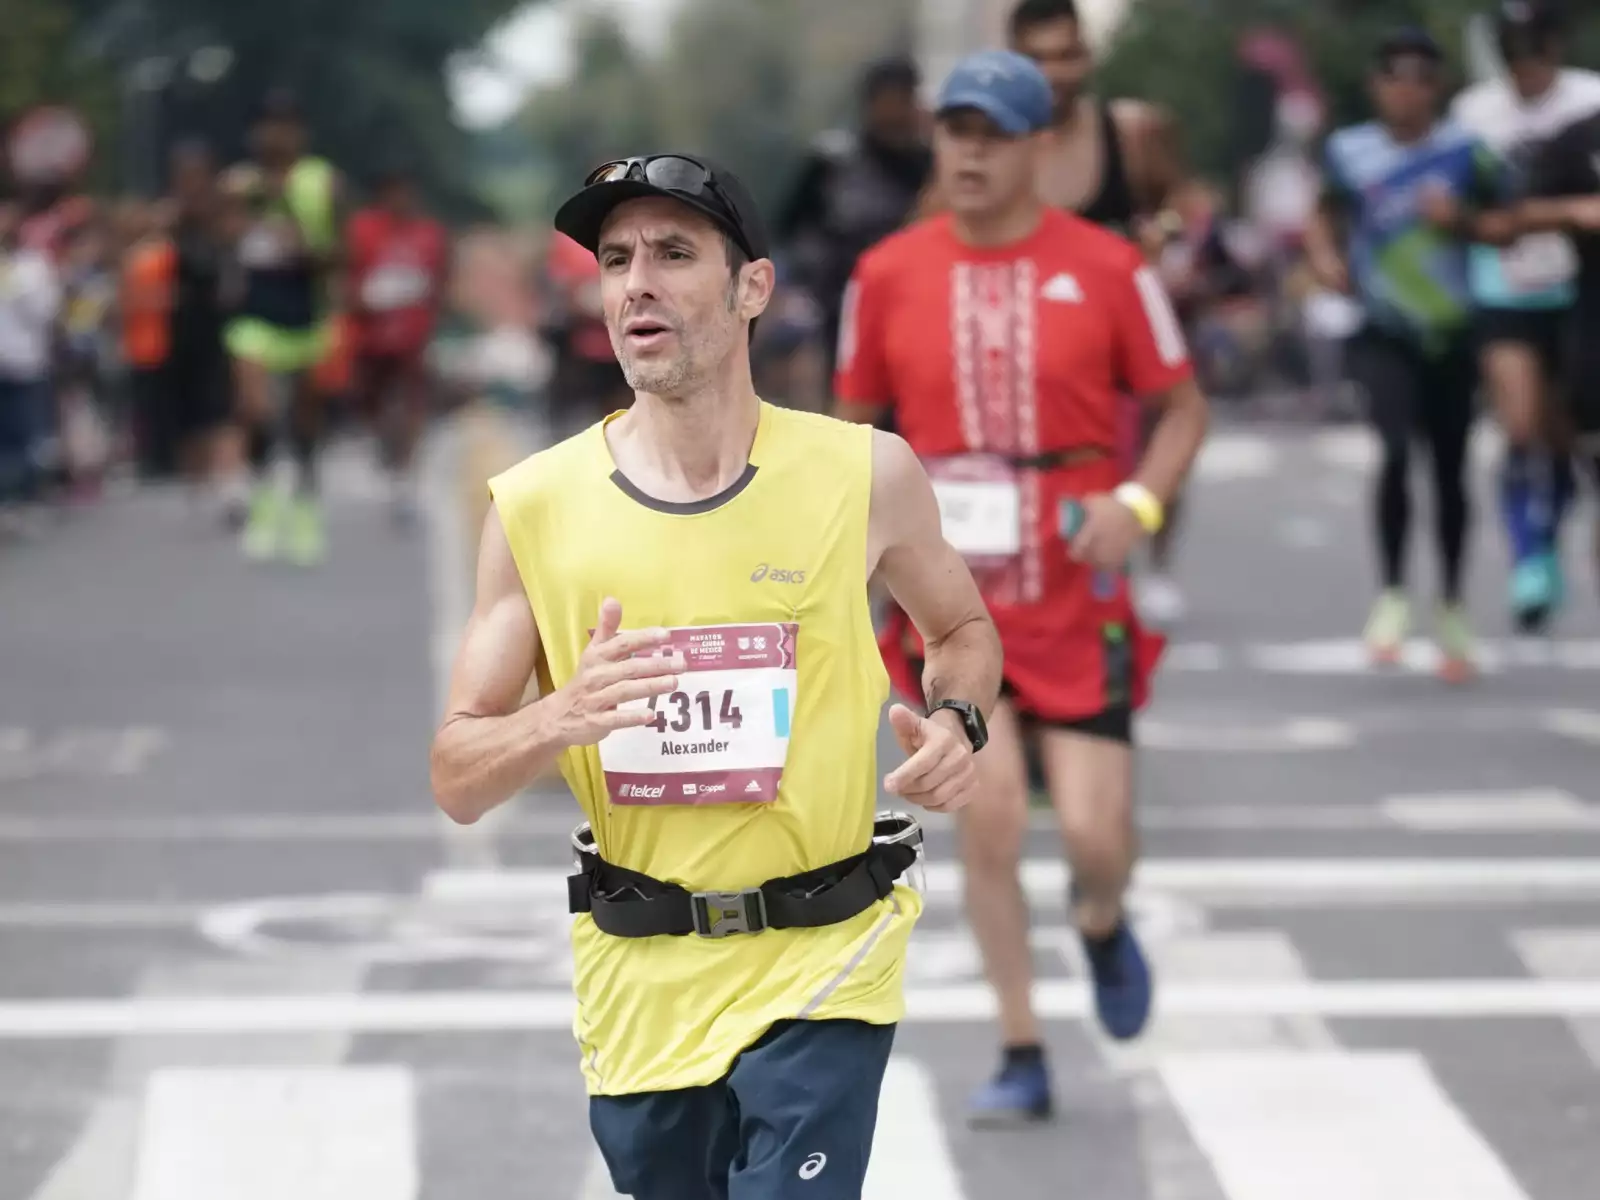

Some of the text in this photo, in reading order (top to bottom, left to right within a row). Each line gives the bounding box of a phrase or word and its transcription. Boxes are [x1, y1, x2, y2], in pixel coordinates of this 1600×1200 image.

[769, 568, 806, 584] asics
[645, 689, 743, 733] 4314
[661, 739, 729, 756] Alexander
[630, 784, 666, 798] telcel
